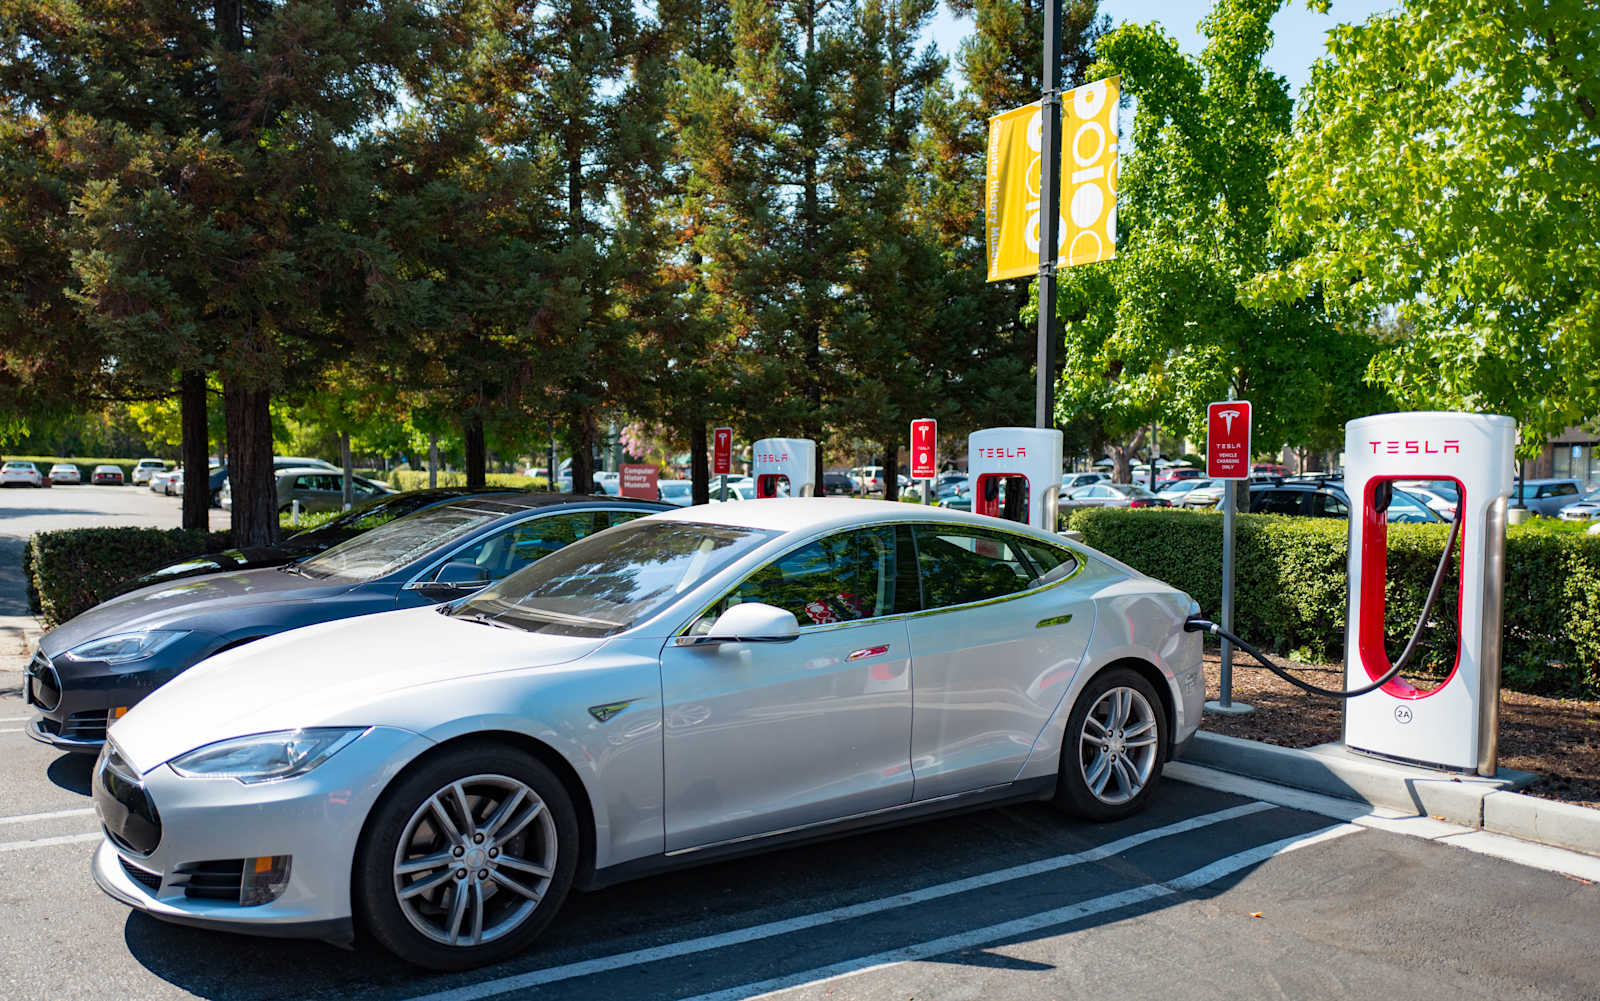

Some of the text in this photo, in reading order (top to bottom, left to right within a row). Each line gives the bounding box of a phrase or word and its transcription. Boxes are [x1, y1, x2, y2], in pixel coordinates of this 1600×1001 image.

[988, 119, 1001, 277] Computer History Museum
[1368, 440, 1460, 454] TESLA
[757, 453, 788, 463] TESLA
[978, 448, 1026, 458] TESLA
[1397, 710, 1410, 719] 2A
